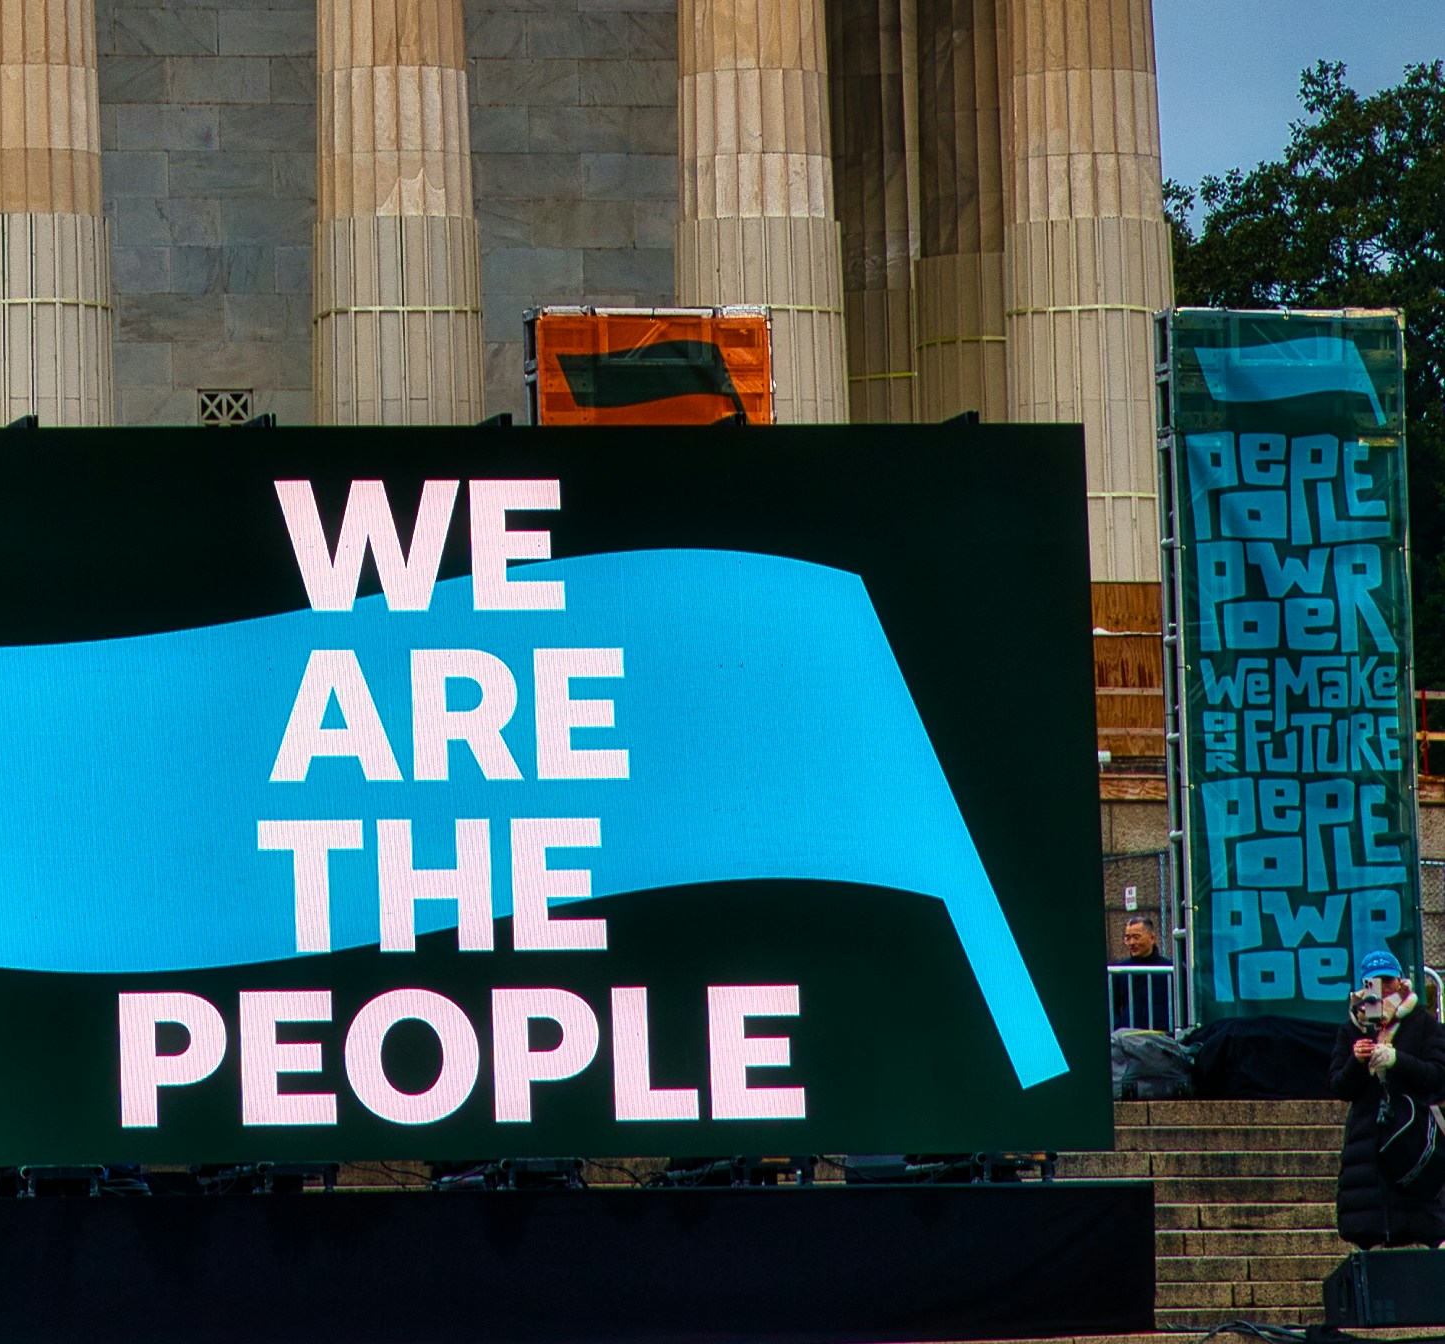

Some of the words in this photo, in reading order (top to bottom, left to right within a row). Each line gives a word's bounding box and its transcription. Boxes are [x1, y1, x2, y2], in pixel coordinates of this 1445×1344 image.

[274, 479, 567, 612] WE
[268, 647, 631, 783] ARE
[1244, 710, 1403, 774] FUTURE
[256, 817, 609, 953] THE
[117, 984, 808, 1129] PEOPLE
